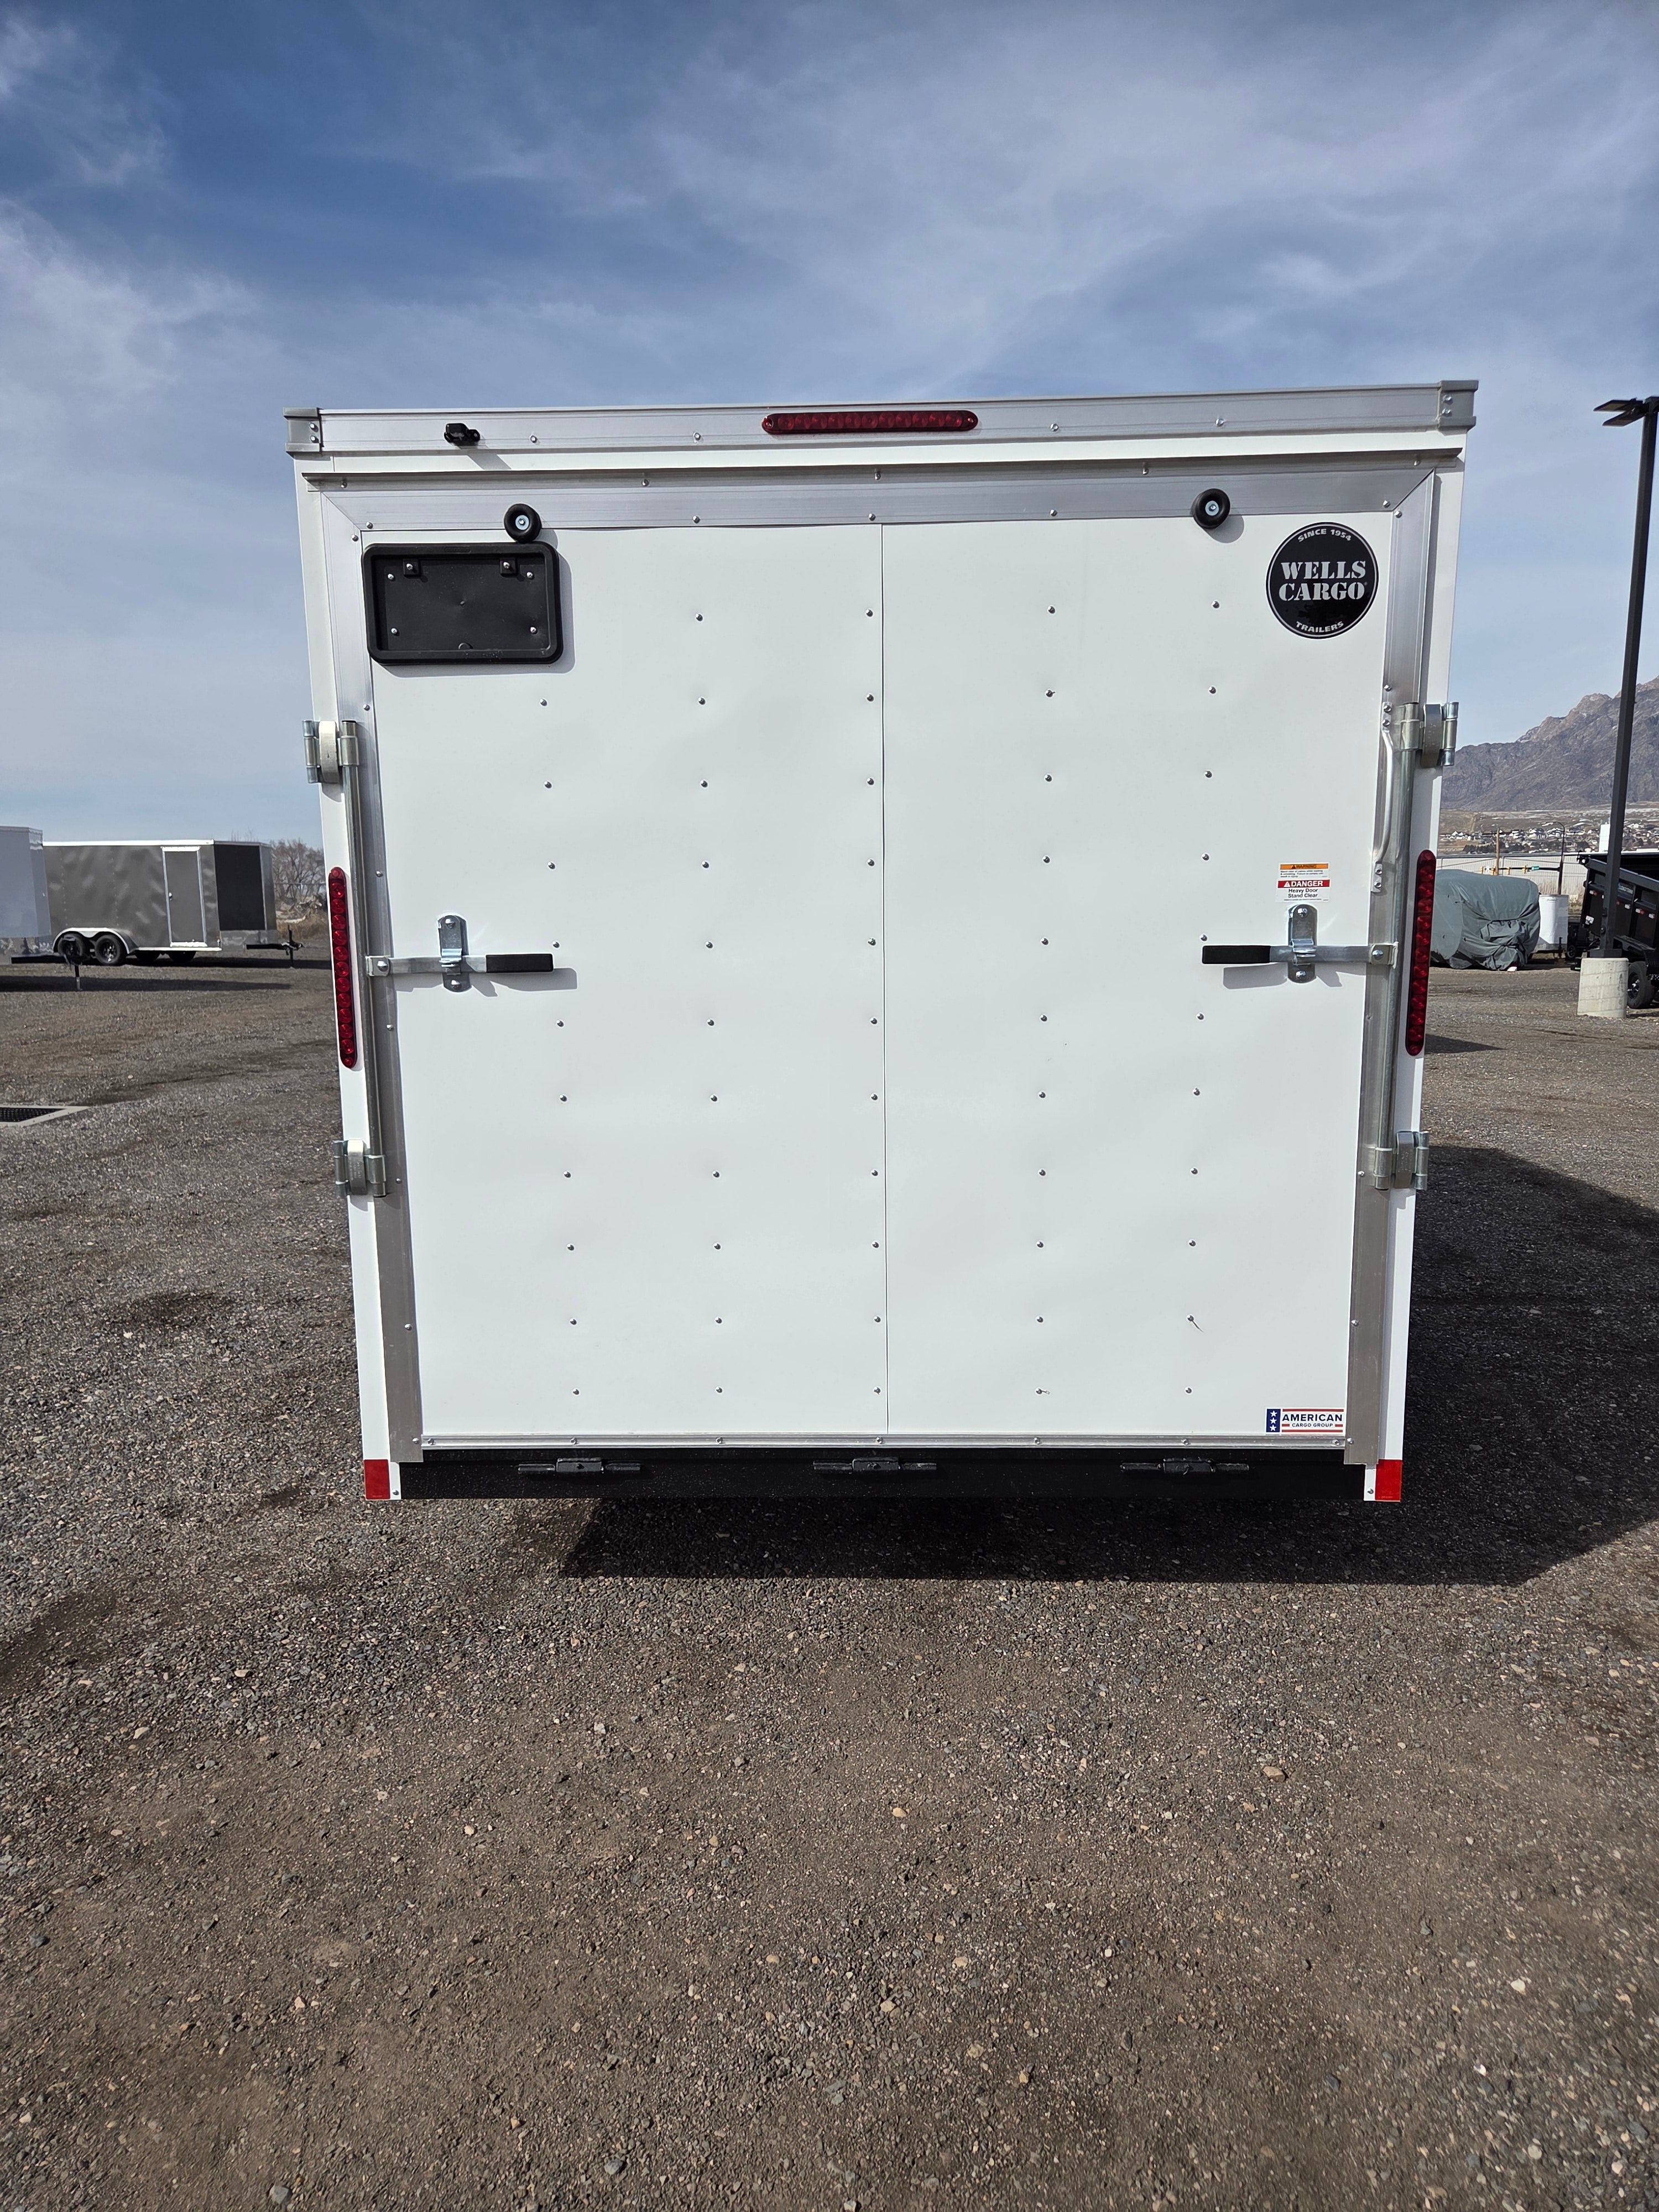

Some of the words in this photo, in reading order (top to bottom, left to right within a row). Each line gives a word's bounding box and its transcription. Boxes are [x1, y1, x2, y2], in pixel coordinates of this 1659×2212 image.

[1297, 529, 1327, 542] SINCE
[1331, 529, 1352, 541] 1954
[1281, 561, 1366, 580] WELLS
[1279, 582, 1365, 601] CARGO
[1296, 621, 1344, 633] TRAILERS
